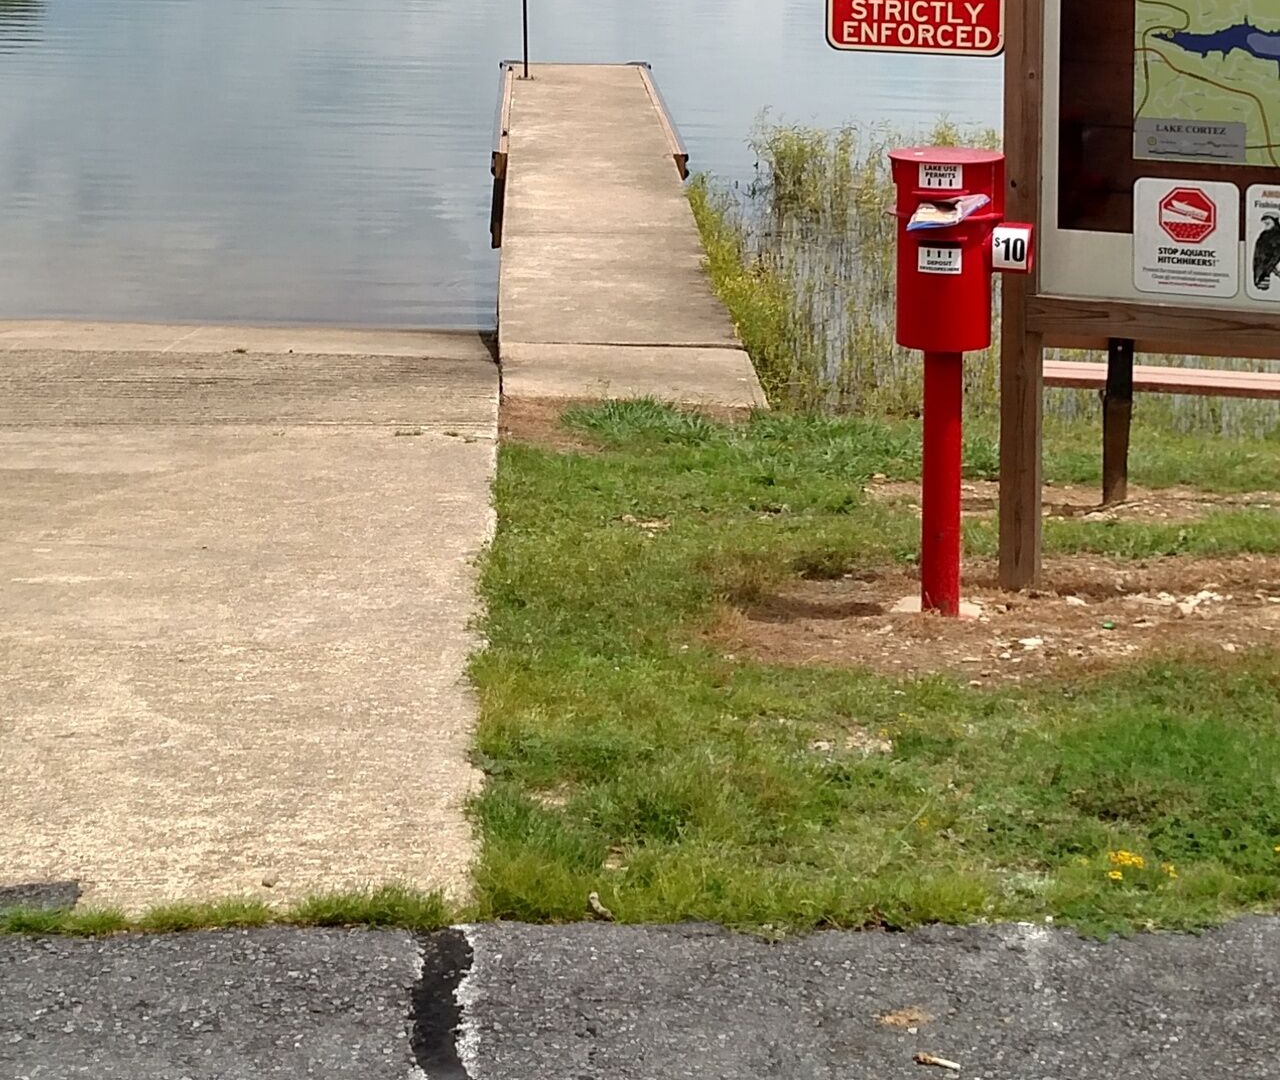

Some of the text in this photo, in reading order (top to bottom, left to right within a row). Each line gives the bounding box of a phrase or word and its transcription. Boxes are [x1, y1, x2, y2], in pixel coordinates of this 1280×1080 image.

[852, 0, 984, 24] STRICTLY
[844, 21, 991, 47] ENFORCED
[1156, 124, 1226, 135] LAKE CORTEZ
[995, 238, 1024, 262] $10
[1158, 247, 1216, 258] STOP AQUATIC
[1158, 256, 1216, 266] HITCHHIKERS!
